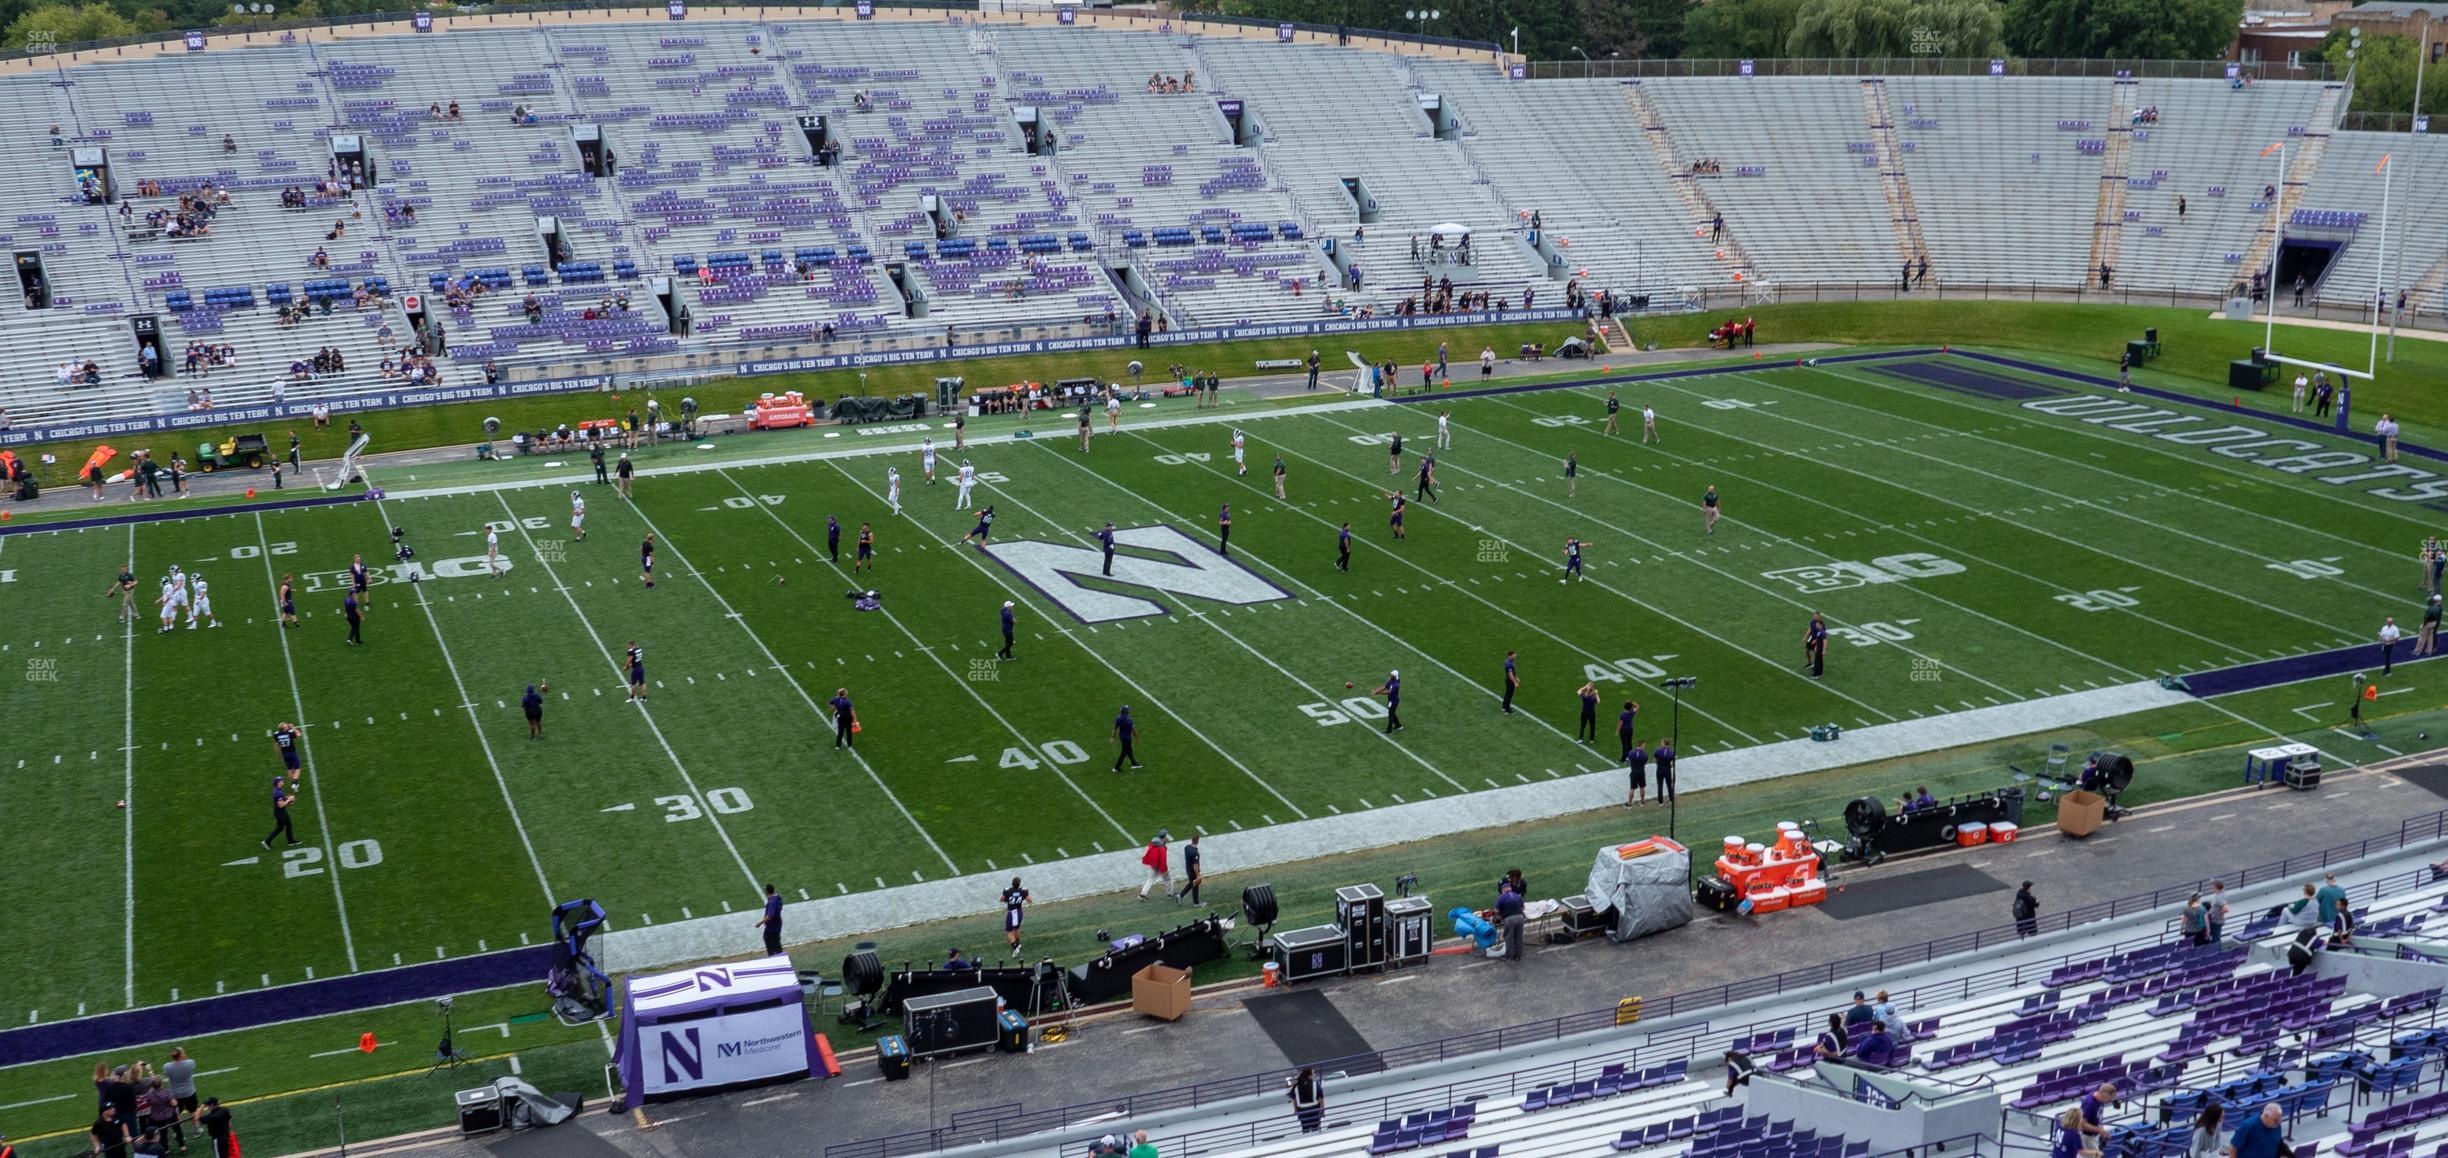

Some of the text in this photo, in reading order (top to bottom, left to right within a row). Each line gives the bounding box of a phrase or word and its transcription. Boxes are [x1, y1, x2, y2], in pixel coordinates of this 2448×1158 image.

[858, 6, 870, 14] 109
[1062, 12, 1072, 20] 110
[417, 18, 430, 26] 107
[1282, 29, 1291, 37] 111
[189, 38, 202, 46] 106
[1514, 69, 1524, 77] 112
[1992, 65, 2002, 73] 114
[1403, 318, 1408, 328] N
[1444, 316, 1454, 324] BIG
[1456, 315, 1467, 324] TEN
[1468, 314, 1486, 323] TEAM
[1490, 313, 1496, 322] N
[1532, 311, 1542, 320] BIG
[1543, 310, 1554, 319] TEN
[1555, 309, 1572, 318] TEAM
[1578, 309, 1584, 318] N
[1223, 329, 1229, 338] N
[1266, 326, 1277, 335] BIG
[1278, 325, 1290, 334] TEN
[1290, 324, 1308, 334] TEAM
[1314, 324, 1320, 332] N
[1356, 320, 1366, 330] BIG
[1367, 320, 1380, 328] TEN
[1380, 318, 1398, 328] TEAM
[1036, 342, 1042, 352] N
[1082, 338, 1093, 348] BIG
[1094, 338, 1106, 347] TEN
[1106, 336, 1124, 346] TEAM
[1130, 336, 1136, 344] N
[1174, 332, 1186, 342] BIG
[1186, 332, 1198, 340] TEN
[1199, 330, 1217, 340] TEAM
[842, 356, 848, 366] N
[889, 352, 900, 362] BIG
[902, 351, 914, 360] TEN
[916, 350, 934, 360] TEAM
[940, 349, 946, 358] N
[986, 345, 998, 354] BIG
[999, 344, 1012, 354] TEN
[1012, 344, 1030, 353] TEAM
[740, 364, 747, 374] N
[790, 360, 801, 370] BIG
[802, 360, 816, 368] TEN
[816, 358, 836, 368] TEAM
[499, 385, 506, 396] N
[550, 380, 563, 391] BIG
[564, 380, 579, 390] TEN
[579, 378, 600, 388] TEAM
[388, 396, 396, 406] N
[442, 390, 455, 400] BIG
[456, 389, 472, 399] TEN
[472, 387, 493, 398] TEAM
[275, 406, 283, 416] N
[330, 400, 344, 410] BIG
[344, 398, 360, 409] TEN
[361, 397, 382, 408] TEAM
[157, 418, 166, 429] N
[214, 411, 228, 422] BIG
[228, 410, 246, 421] TEN
[246, 408, 269, 420] TEAM
[34, 430, 42, 440] N
[94, 423, 108, 435] BIG
[109, 422, 126, 434] TEN
[127, 420, 150, 432] TEAM
[2, 433, 27, 444] TEAM
[2022, 394, 2448, 500] WILDCATS
[978, 524, 1293, 624] N
[2266, 559, 2344, 579] 10
[2054, 589, 2140, 612] 20
[1826, 621, 1914, 647] 30
[1582, 658, 1667, 682] 40
[1298, 696, 1388, 726] 50
[998, 740, 1090, 770] 40
[654, 786, 754, 822] 30
[281, 838, 384, 879] 20
[696, 968, 732, 992] N
[744, 1030, 802, 1048] Northwestern
[661, 1028, 703, 1084] N
[744, 1044, 782, 1055] Medicine
